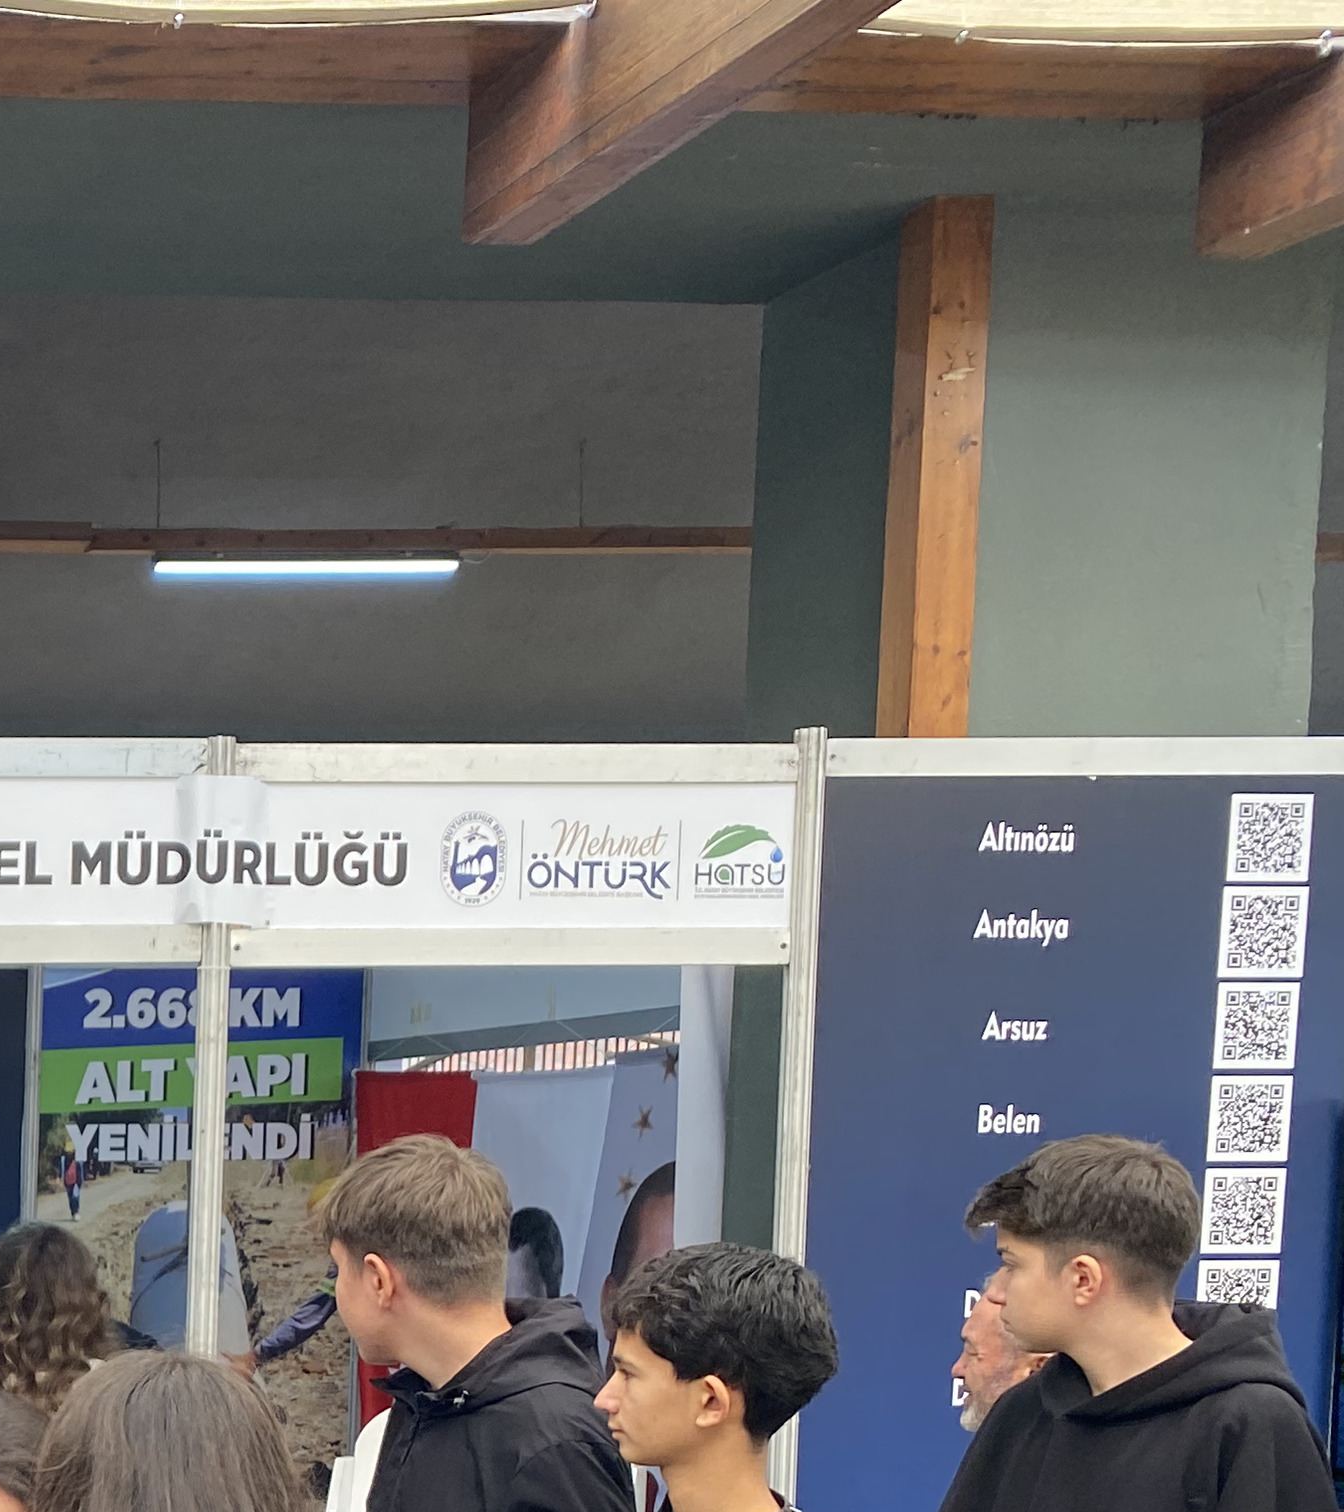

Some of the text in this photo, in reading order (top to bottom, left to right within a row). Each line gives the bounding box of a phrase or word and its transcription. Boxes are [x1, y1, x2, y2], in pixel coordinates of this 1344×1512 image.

[551, 818, 669, 859] Mehmet
[978, 822, 1076, 853] Altınözü
[72, 830, 408, 888] MÜDÜRLÜĞÜ
[527, 853, 671, 900] ÖNTÜRK
[973, 908, 1070, 946] Antakya
[229, 987, 301, 1028] KM
[981, 1011, 1048, 1042] Arsuz
[74, 1053, 306, 1105] ALT API
[65, 1113, 311, 1162] YENİLNDİ
[977, 1104, 1040, 1134] Belen
